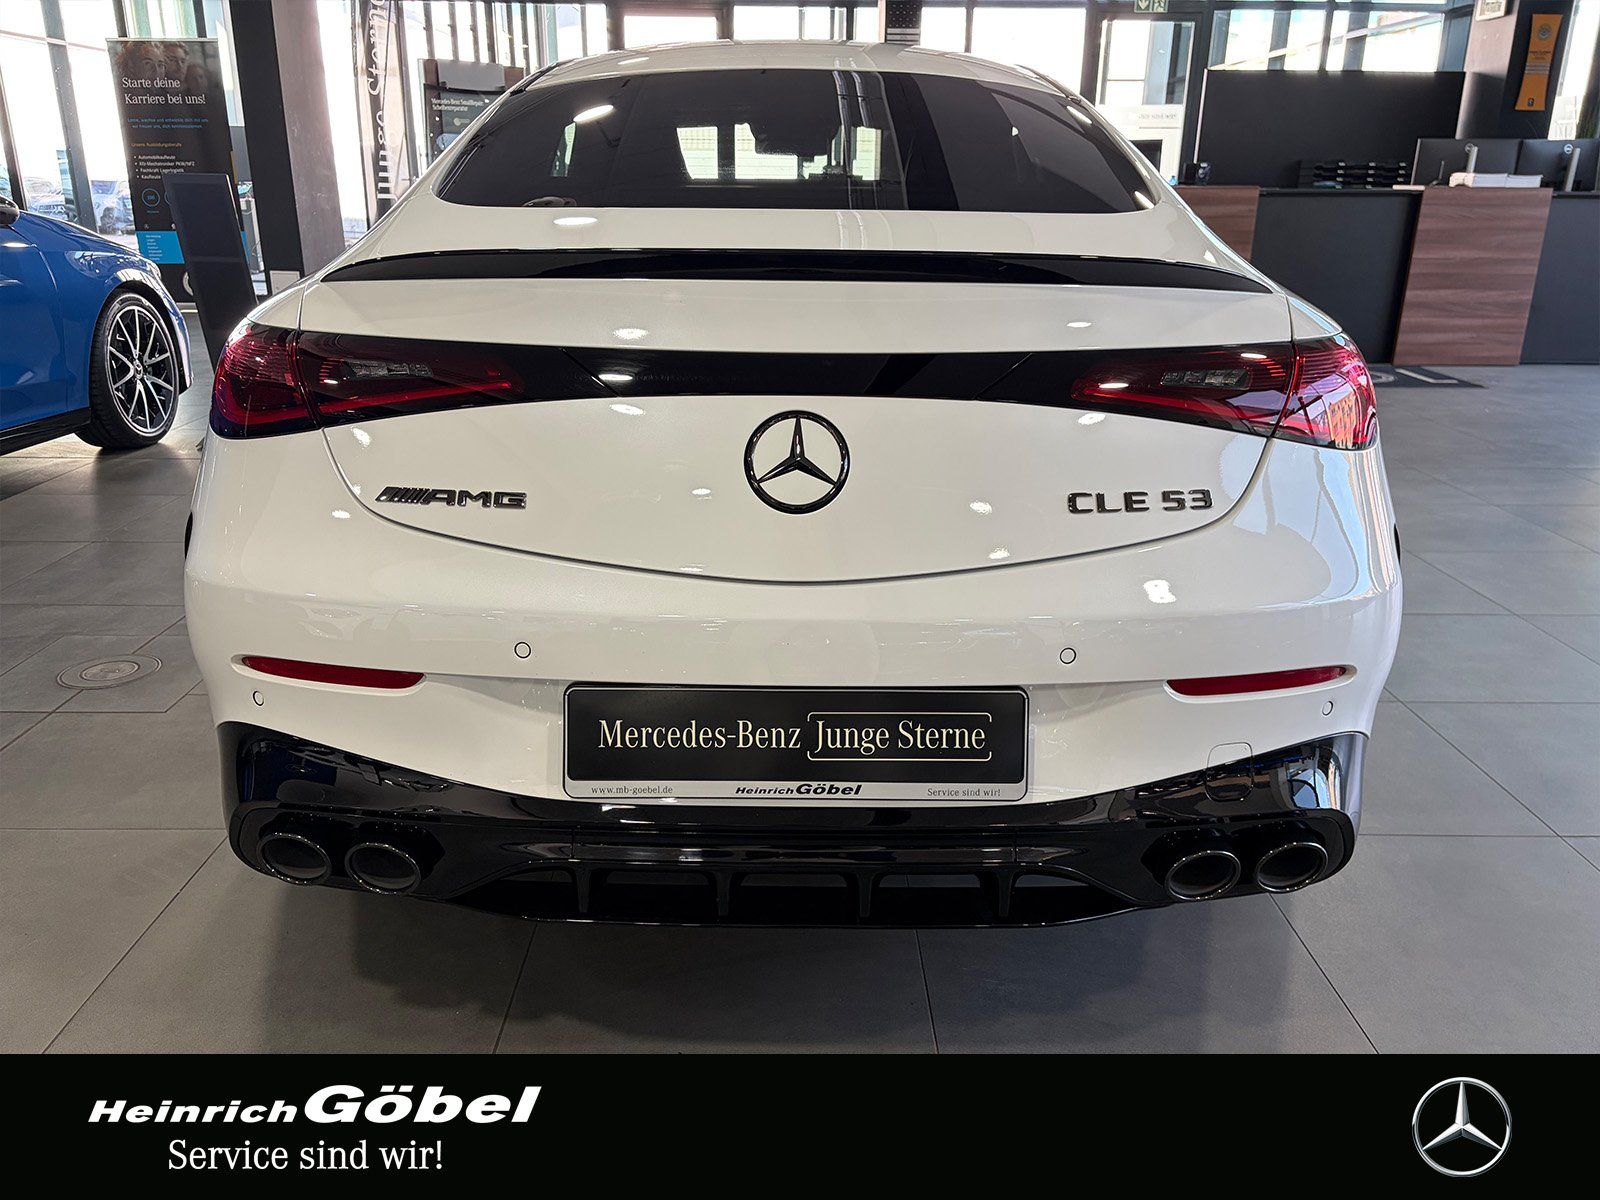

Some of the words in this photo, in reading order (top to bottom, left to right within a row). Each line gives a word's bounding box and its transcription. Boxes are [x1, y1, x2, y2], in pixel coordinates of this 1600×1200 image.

[122, 77, 151, 88] Starte
[153, 77, 181, 88] deine
[124, 93, 166, 105] Karriere
[167, 93, 183, 105] bei
[185, 94, 206, 105] uns!
[420, 488, 527, 509] AMG
[1067, 491, 1150, 514] CLE
[1161, 488, 1213, 511] 53
[598, 719, 801, 749] Mercedes-Benz
[814, 720, 889, 755] Junge
[898, 719, 986, 750] Sterne
[591, 785, 673, 795] www.mb-goebel.de
[927, 787, 960, 797] Service
[962, 788, 981, 797] sind
[983, 788, 1001, 797] wir!
